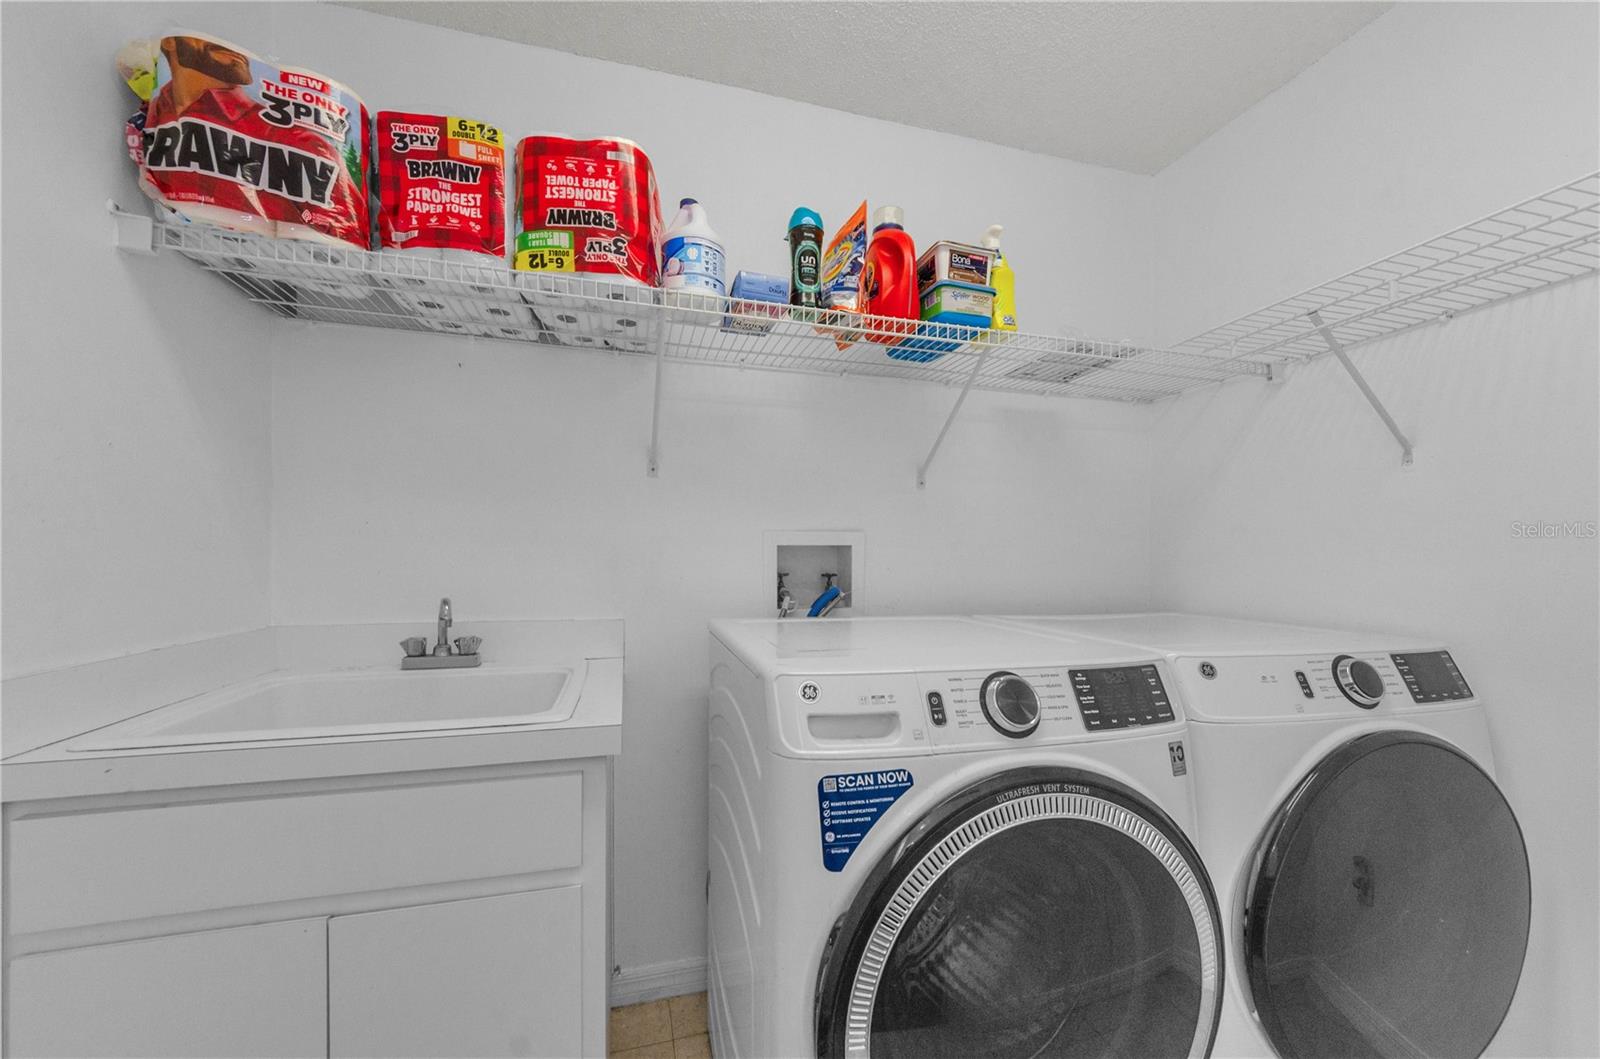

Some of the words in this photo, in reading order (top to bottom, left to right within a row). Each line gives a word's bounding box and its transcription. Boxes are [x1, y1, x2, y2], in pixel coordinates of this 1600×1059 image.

[287, 74, 322, 91] NEW
[263, 79, 298, 100] THE
[302, 92, 346, 117] ONLY
[261, 91, 345, 134] 3PLY
[392, 124, 411, 133] THE
[413, 125, 438, 134] ONLY
[452, 130, 476, 139] DOUBLE
[392, 132, 438, 151] 3PLY
[406, 160, 481, 184] BRAWNY
[545, 174, 580, 187] TOWEL
[438, 181, 452, 191] THE
[582, 177, 617, 190] PAPER
[407, 187, 482, 206] STRONGEST
[545, 186, 618, 203] STRONGEST
[406, 200, 443, 214] PAPER
[446, 204, 483, 218] TOWEL
[546, 208, 615, 229] BRAWNY
[587, 238, 627, 256] 3PLY
[587, 253, 608, 261] ONLY
[951, 253, 971, 265] Bona
[838, 774, 874, 788] SCAN
[877, 771, 908, 785] NOW
[995, 784, 1040, 804] ULTRAFRESH
[1042, 783, 1060, 792] VENT
[1063, 784, 1090, 794] SYSTEM
